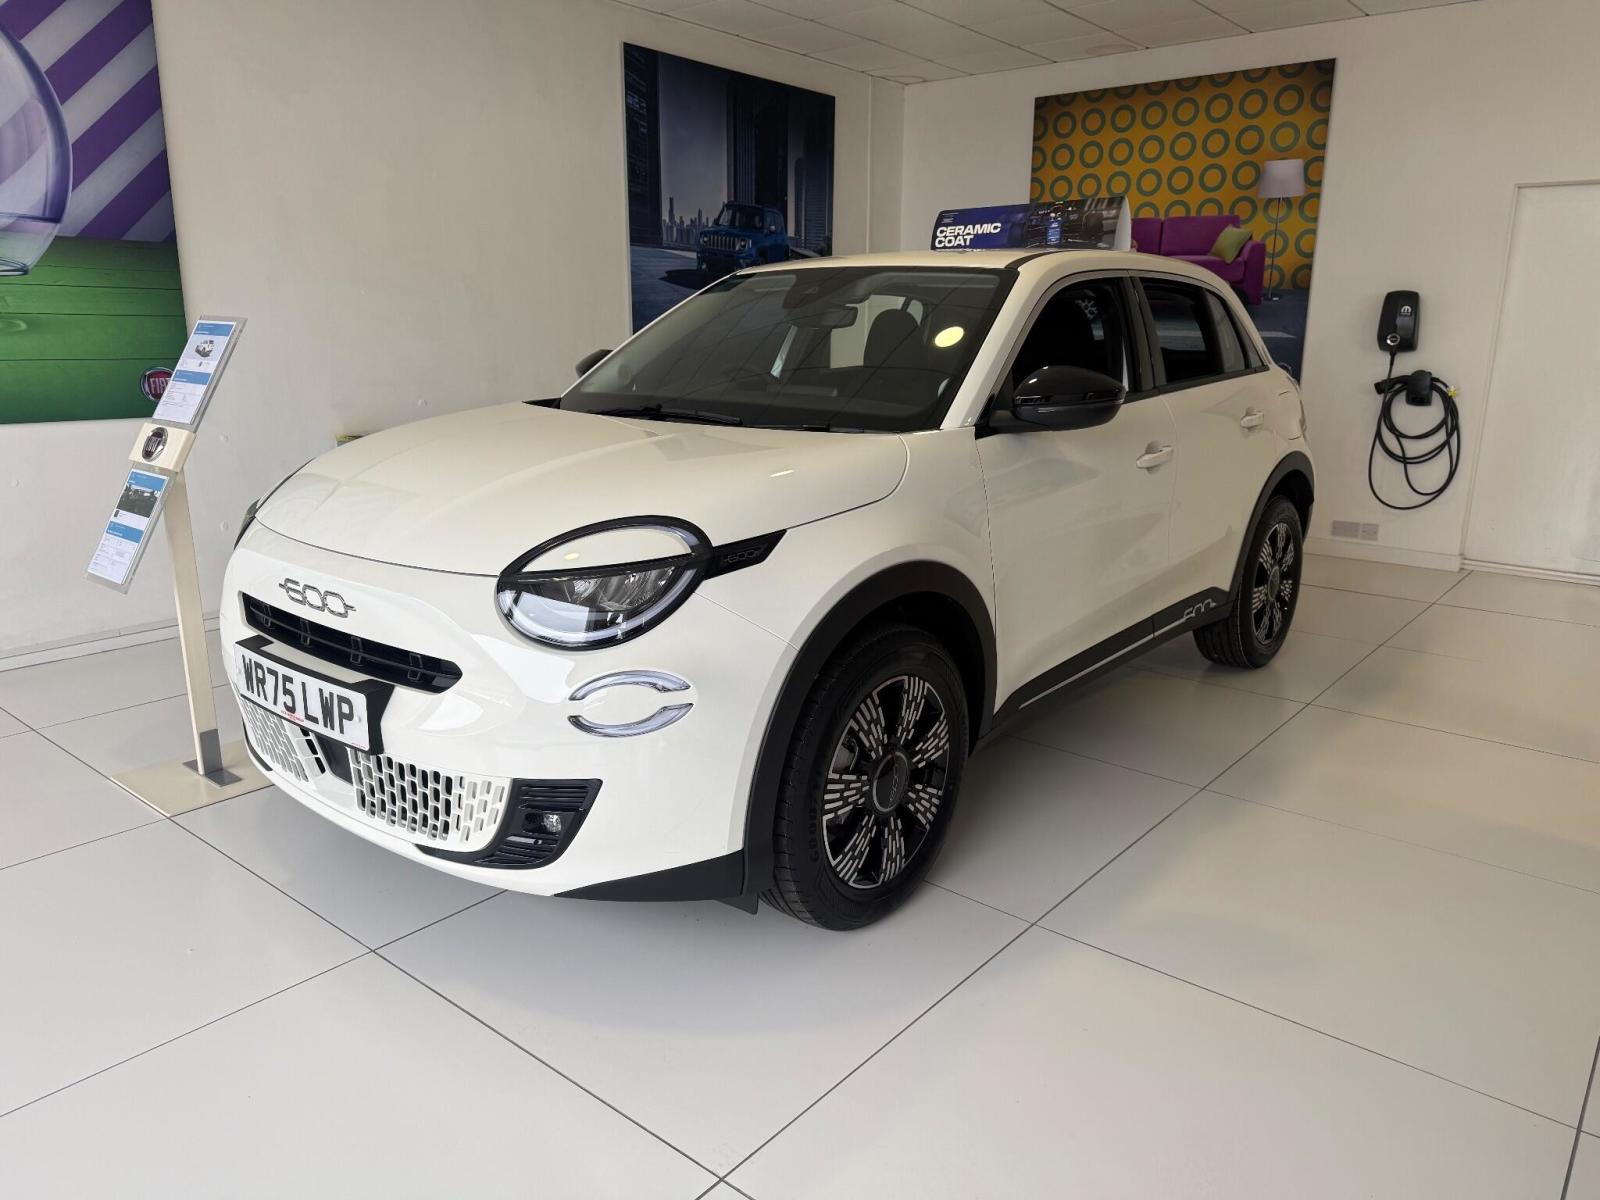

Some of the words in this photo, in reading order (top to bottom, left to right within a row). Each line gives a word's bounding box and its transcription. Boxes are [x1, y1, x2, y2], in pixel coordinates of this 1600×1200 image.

[937, 223, 1001, 237] CERAMIC
[935, 235, 973, 247] COAT
[150, 377, 171, 394] FIA
[279, 578, 356, 618] 600
[242, 654, 297, 714] WR75
[301, 681, 354, 735] LWP
